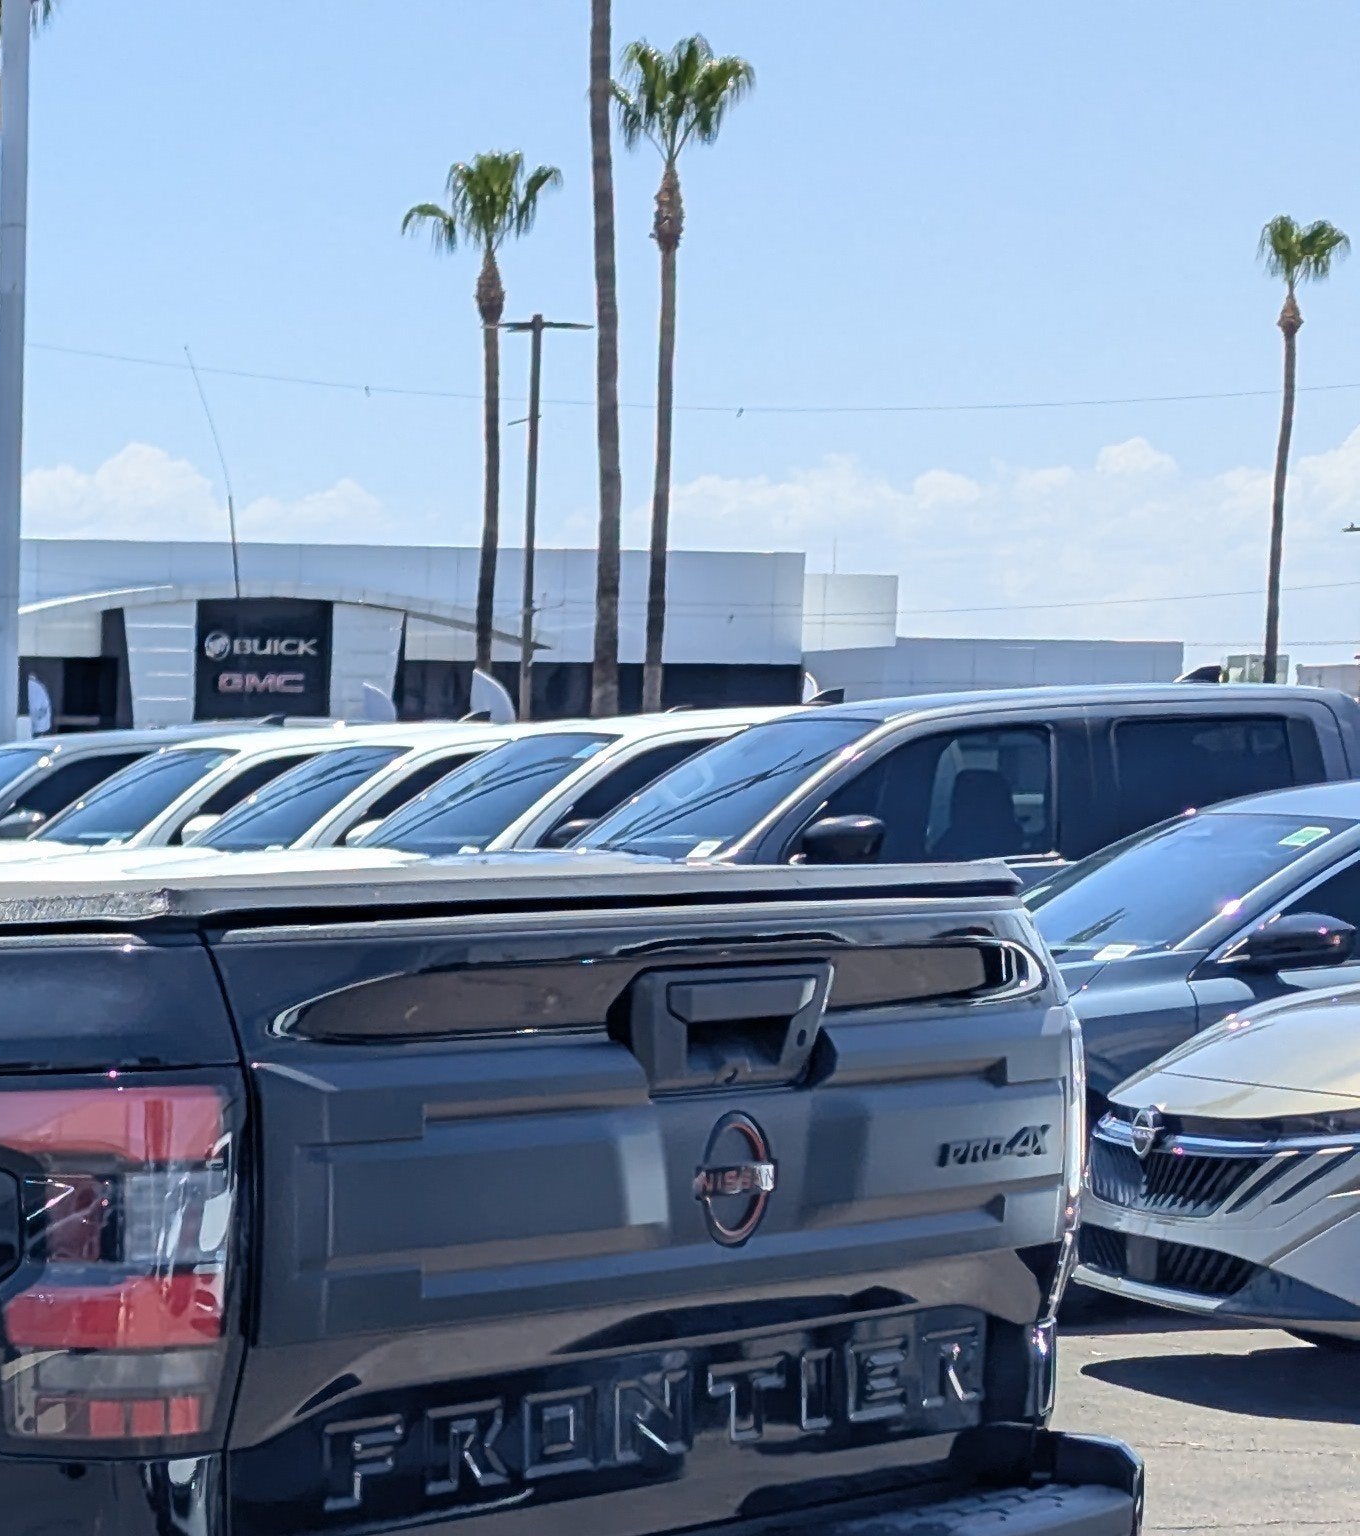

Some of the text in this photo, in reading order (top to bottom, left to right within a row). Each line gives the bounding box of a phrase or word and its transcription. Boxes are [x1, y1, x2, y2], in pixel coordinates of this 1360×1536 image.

[233, 638, 318, 656] BUICK
[218, 672, 305, 693] GMC
[323, 1326, 982, 1511] FRONTIER
